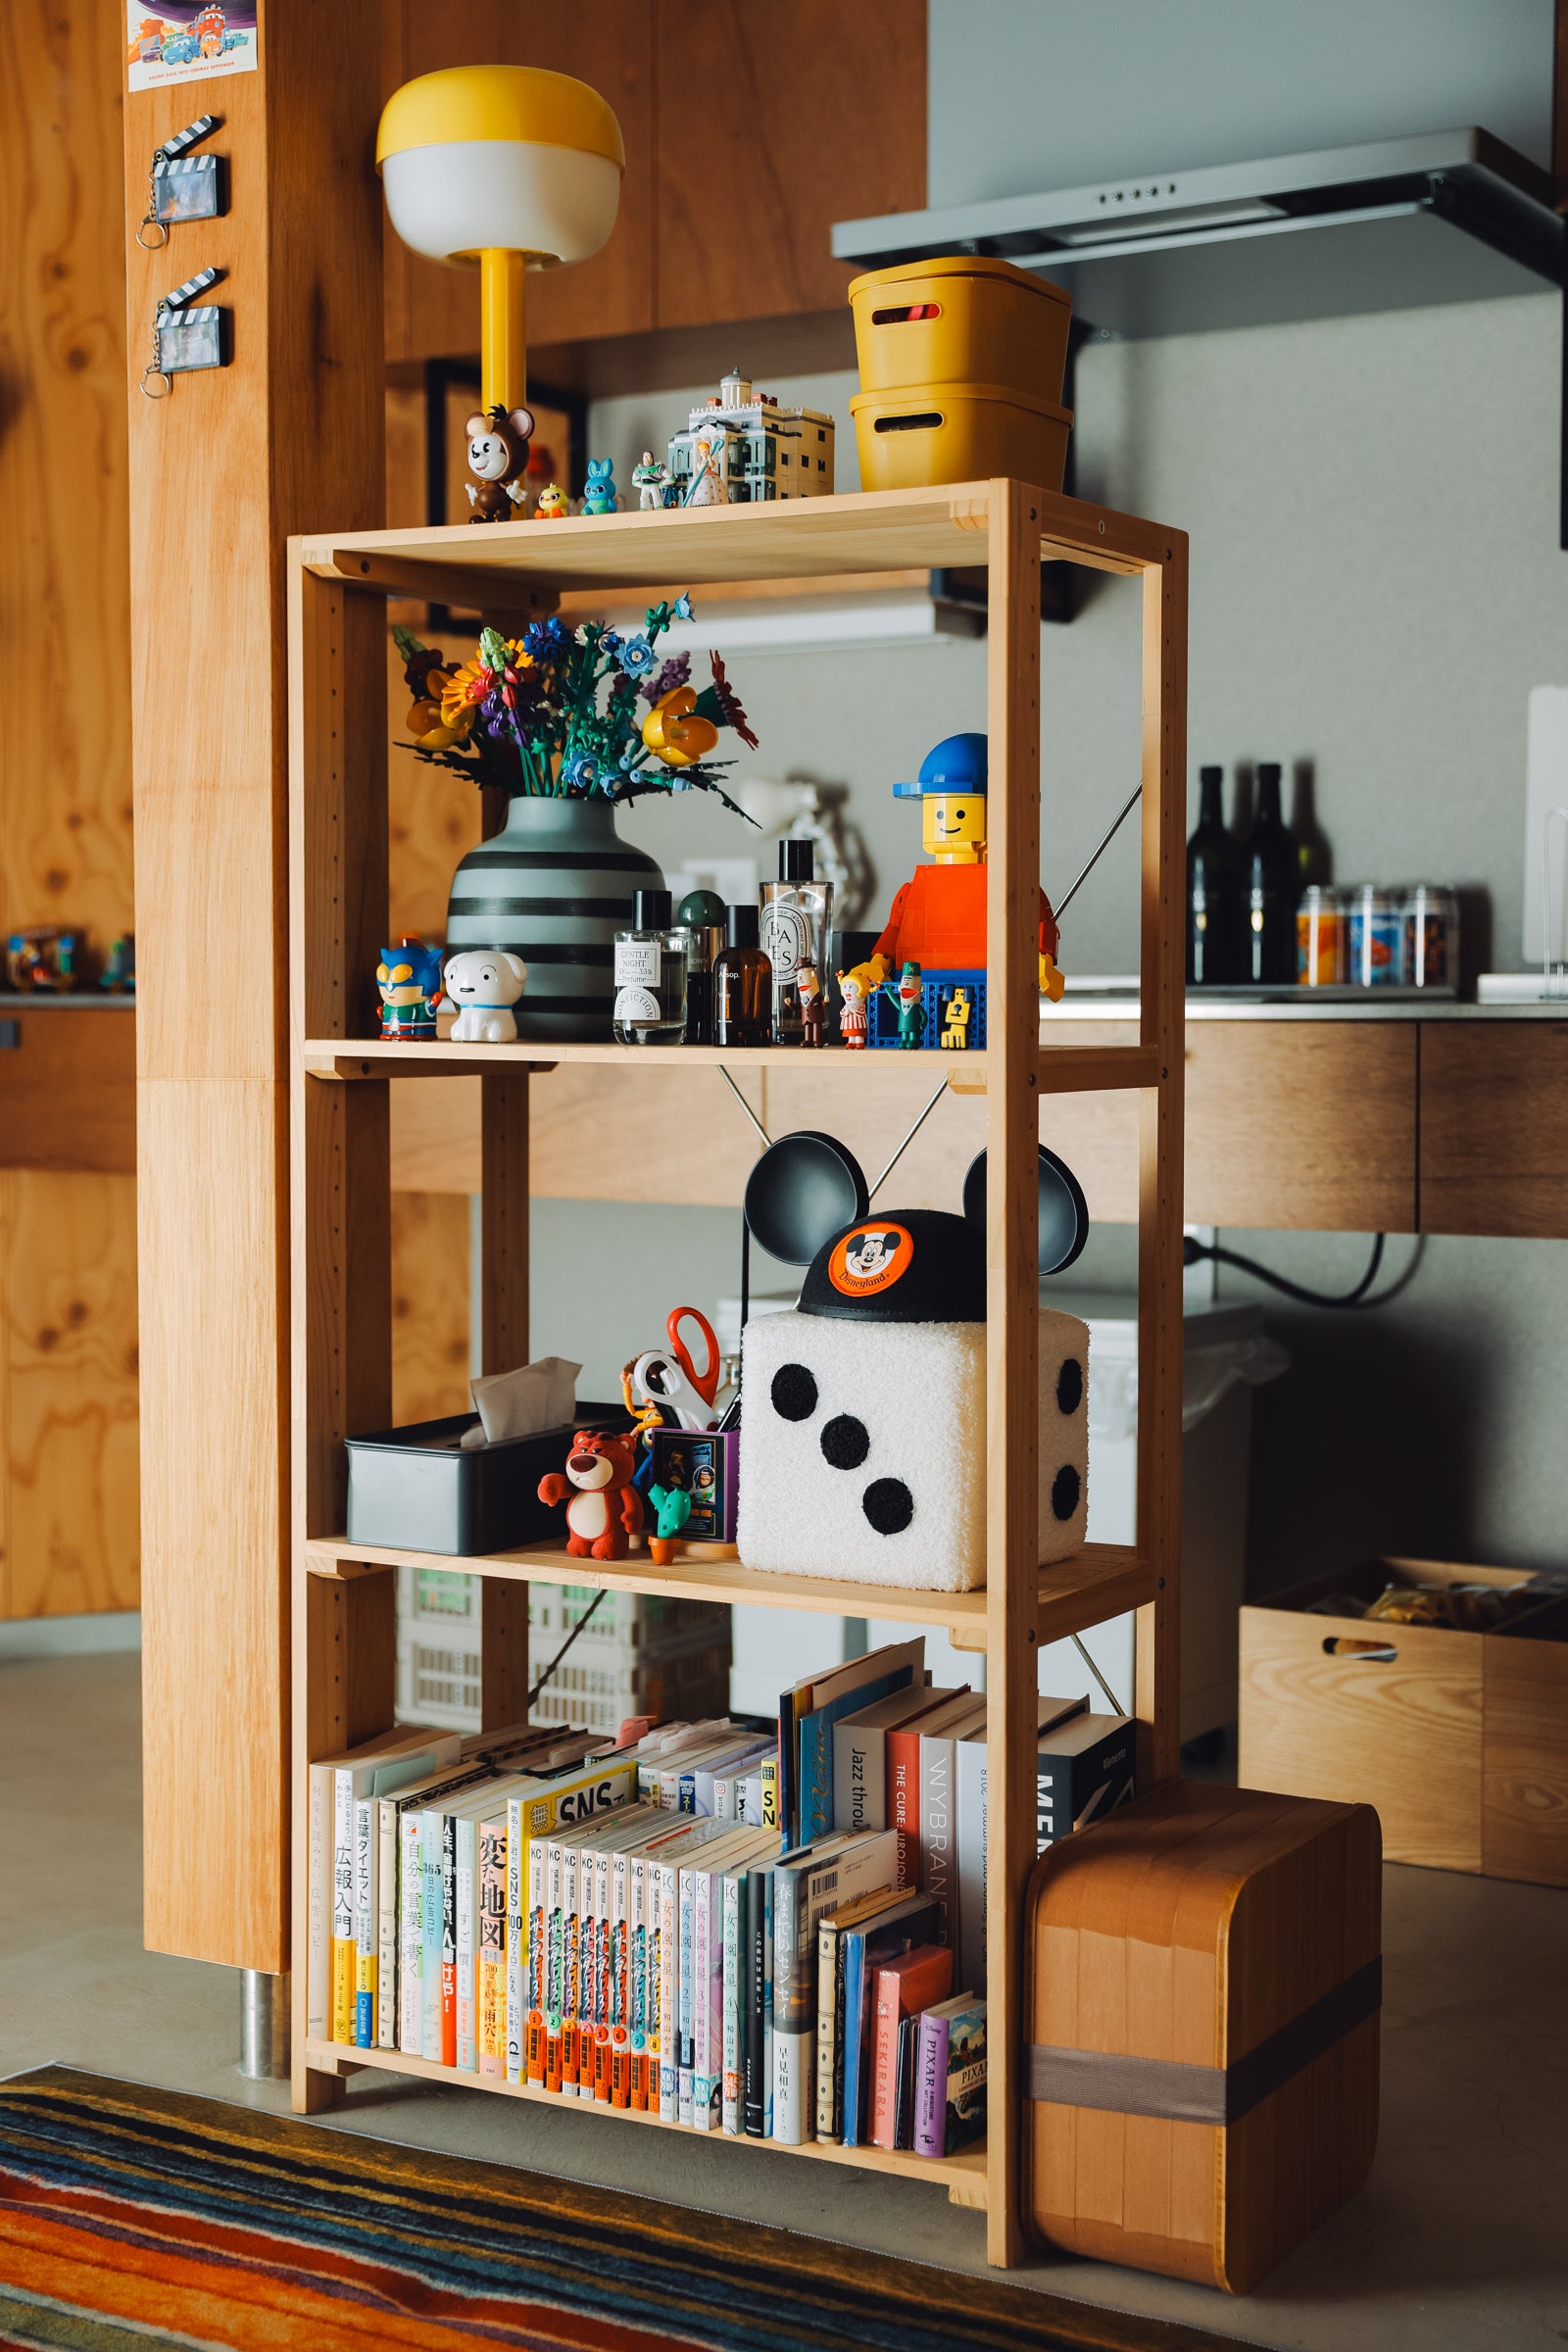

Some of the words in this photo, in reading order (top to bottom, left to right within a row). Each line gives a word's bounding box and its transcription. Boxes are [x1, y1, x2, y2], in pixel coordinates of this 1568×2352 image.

[617, 993, 655, 1018] NONFICTION
[839, 1269, 887, 1289] Disneyland
[853, 1747, 866, 1781] Jazz
[1102, 1748, 1126, 1770] Memento
[896, 1765, 906, 1787] THE
[896, 1791, 906, 1828] CURE:
[358, 1809, 369, 1903] 言葉ダイエット
[531, 1848, 541, 1860] KC
[549, 1850, 561, 1861] KC
[564, 1855, 576, 1867] KC
[582, 1858, 593, 1869] KC
[596, 1861, 607, 1872] KC
[613, 1861, 624, 1873] KC
[632, 1866, 643, 1878] KC
[649, 1869, 661, 1881] KC
[335, 1845, 353, 1936] 広報入門
[480, 1834, 508, 1950] 変な地図
[407, 1840, 422, 1978] 自分の言葉で書く
[778, 1884, 792, 2020] 春までのセンセイ
[484, 2009, 497, 2037] 雨穴
[779, 2046, 789, 2101] 早見和真
[876, 2032, 889, 2117] SEKIRARA
[925, 2039, 937, 2091] PIXAR
